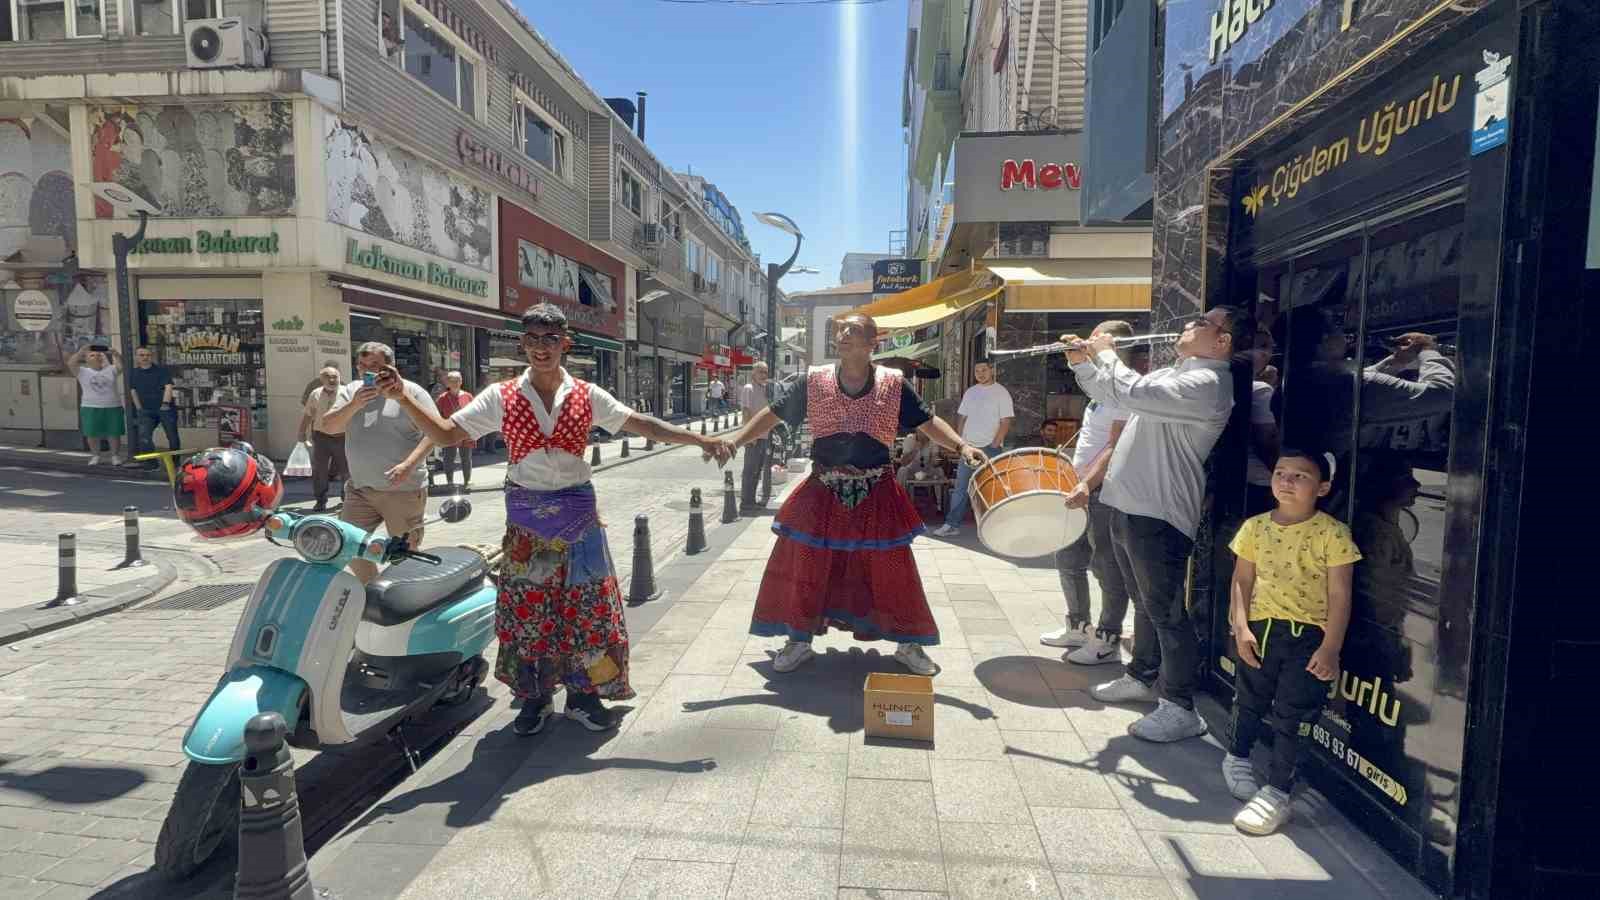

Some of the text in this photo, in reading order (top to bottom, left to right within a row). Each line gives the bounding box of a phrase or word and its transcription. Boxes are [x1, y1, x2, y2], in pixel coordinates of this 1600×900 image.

[1271, 73, 1461, 206] Çiğdem Uğurlu
[196, 229, 279, 254] Baharat
[350, 238, 428, 282] Lokman
[430, 261, 489, 298] Baharat
[1332, 738, 1345, 759] 93
[1346, 748, 1360, 770] 67
